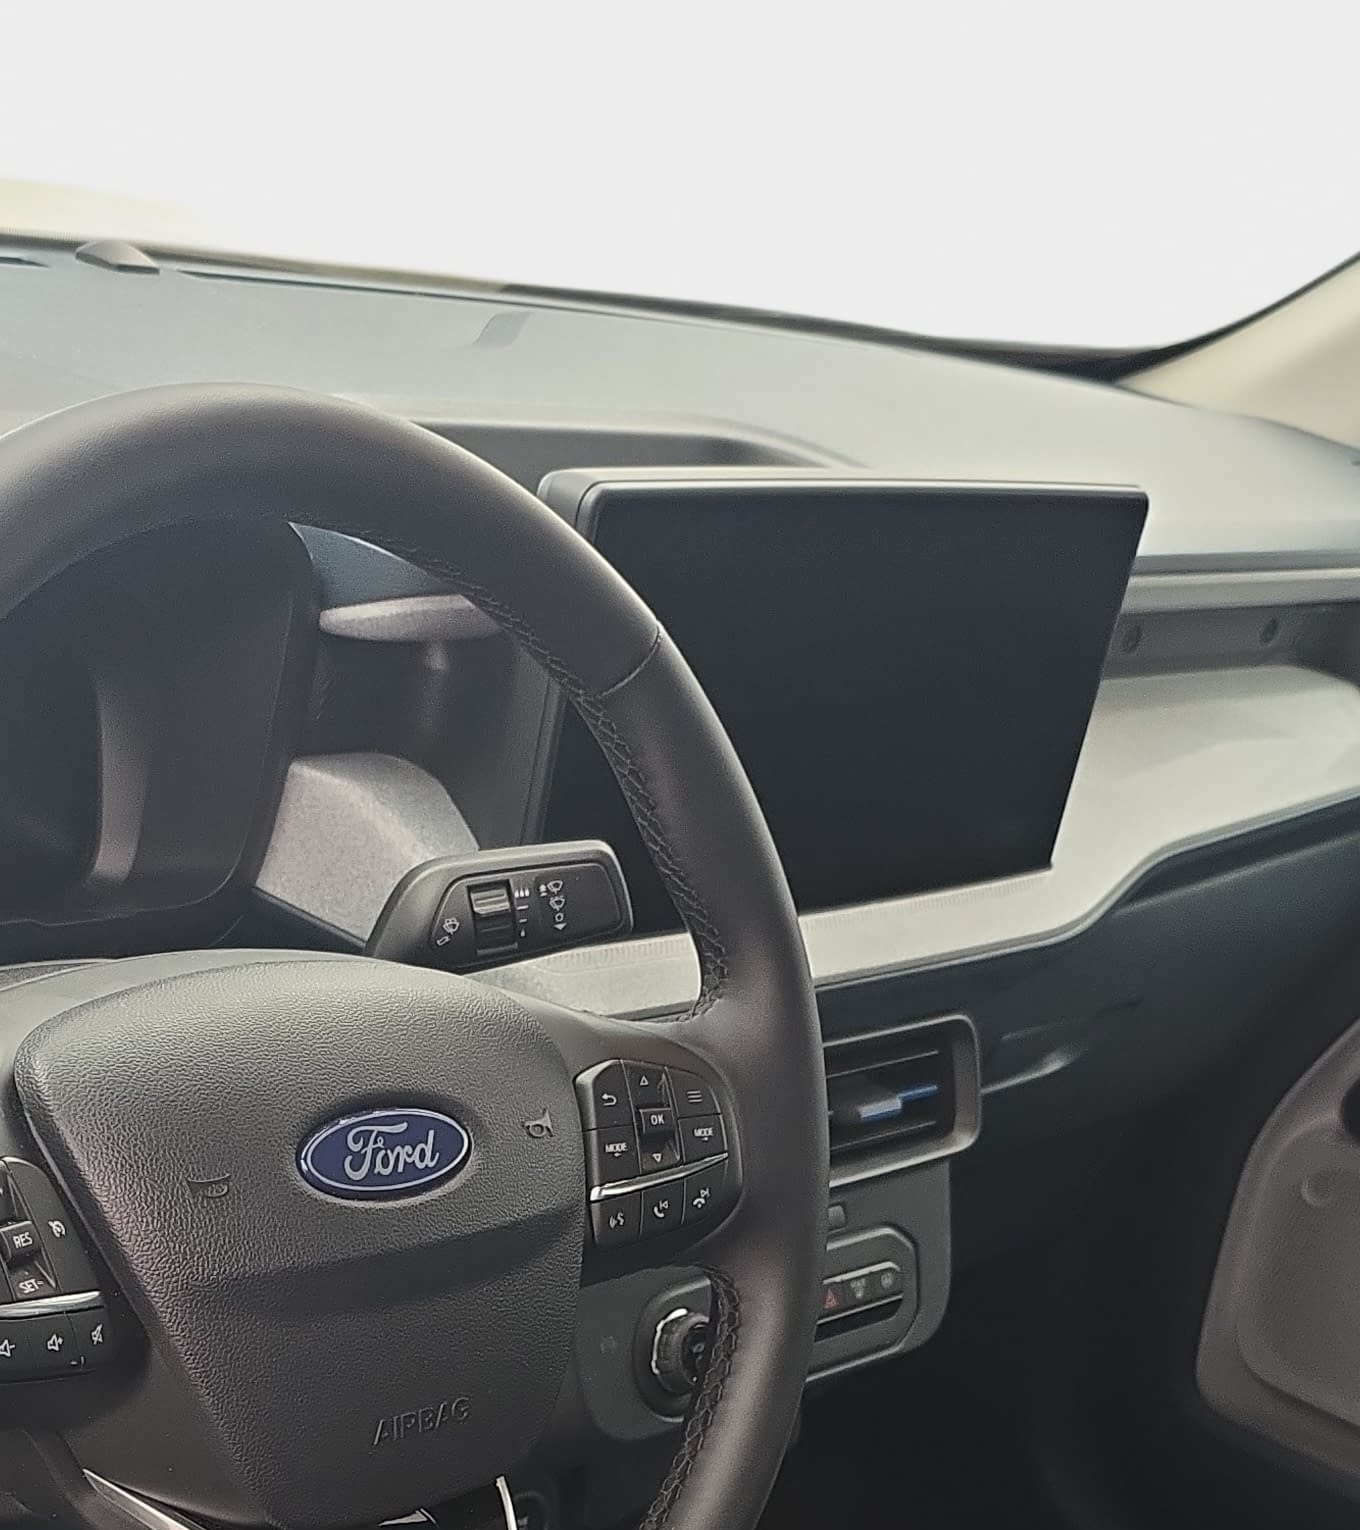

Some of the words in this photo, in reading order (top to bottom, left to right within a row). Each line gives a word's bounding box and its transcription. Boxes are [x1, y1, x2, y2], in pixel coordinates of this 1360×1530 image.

[650, 1114, 665, 1125] OK
[693, 1127, 714, 1137] MODE
[344, 1122, 439, 1181] Ford
[605, 1142, 628, 1153] MODE
[13, 1231, 33, 1249] RES
[371, 1396, 471, 1446] AIRBAG
